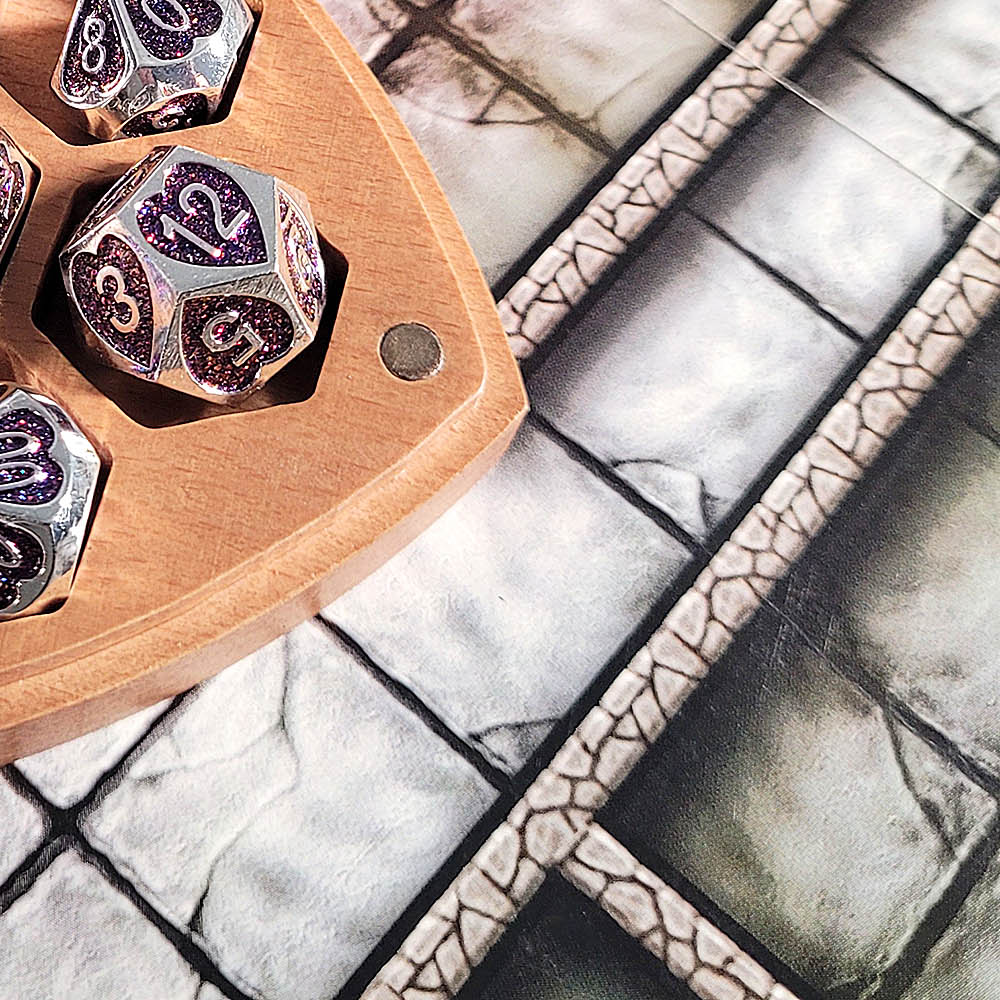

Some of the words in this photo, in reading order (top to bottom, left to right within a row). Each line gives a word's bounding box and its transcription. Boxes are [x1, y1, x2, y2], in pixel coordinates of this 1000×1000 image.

[81, 17, 106, 72] 8
[159, 182, 249, 258] 12
[96, 266, 140, 333] 3
[202, 309, 265, 366] 5
